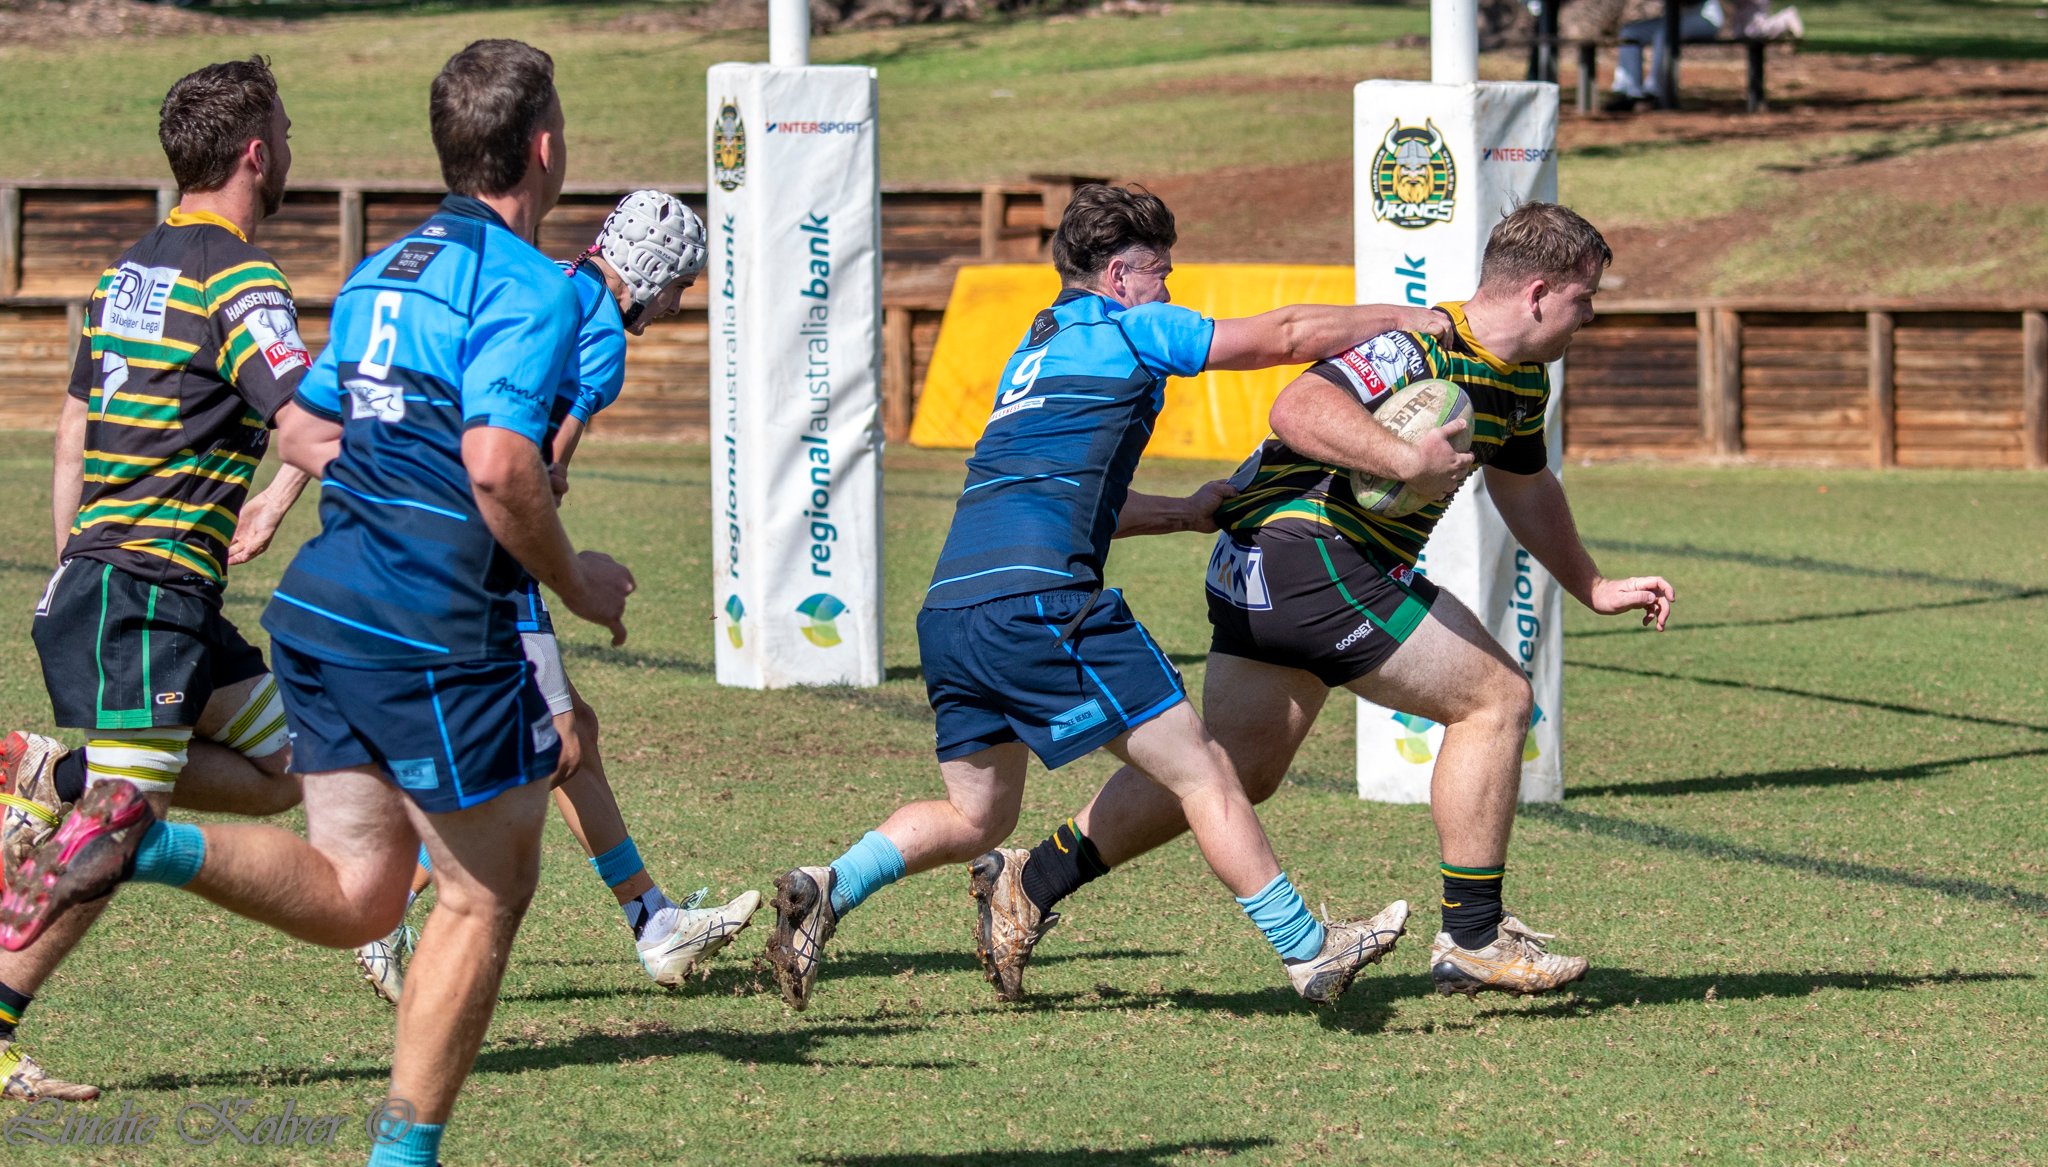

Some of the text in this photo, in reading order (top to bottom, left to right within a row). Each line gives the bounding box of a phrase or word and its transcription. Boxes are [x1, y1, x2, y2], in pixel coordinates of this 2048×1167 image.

[779, 122, 862, 134] INTERSPORT
[1492, 148, 1554, 162] INTERSPO
[1372, 199, 1455, 222] VIKINGS
[140, 318, 160, 334] Legal
[357, 290, 402, 381] 6
[1001, 345, 1049, 405] 9
[1335, 618, 1374, 651] GOOSEY
